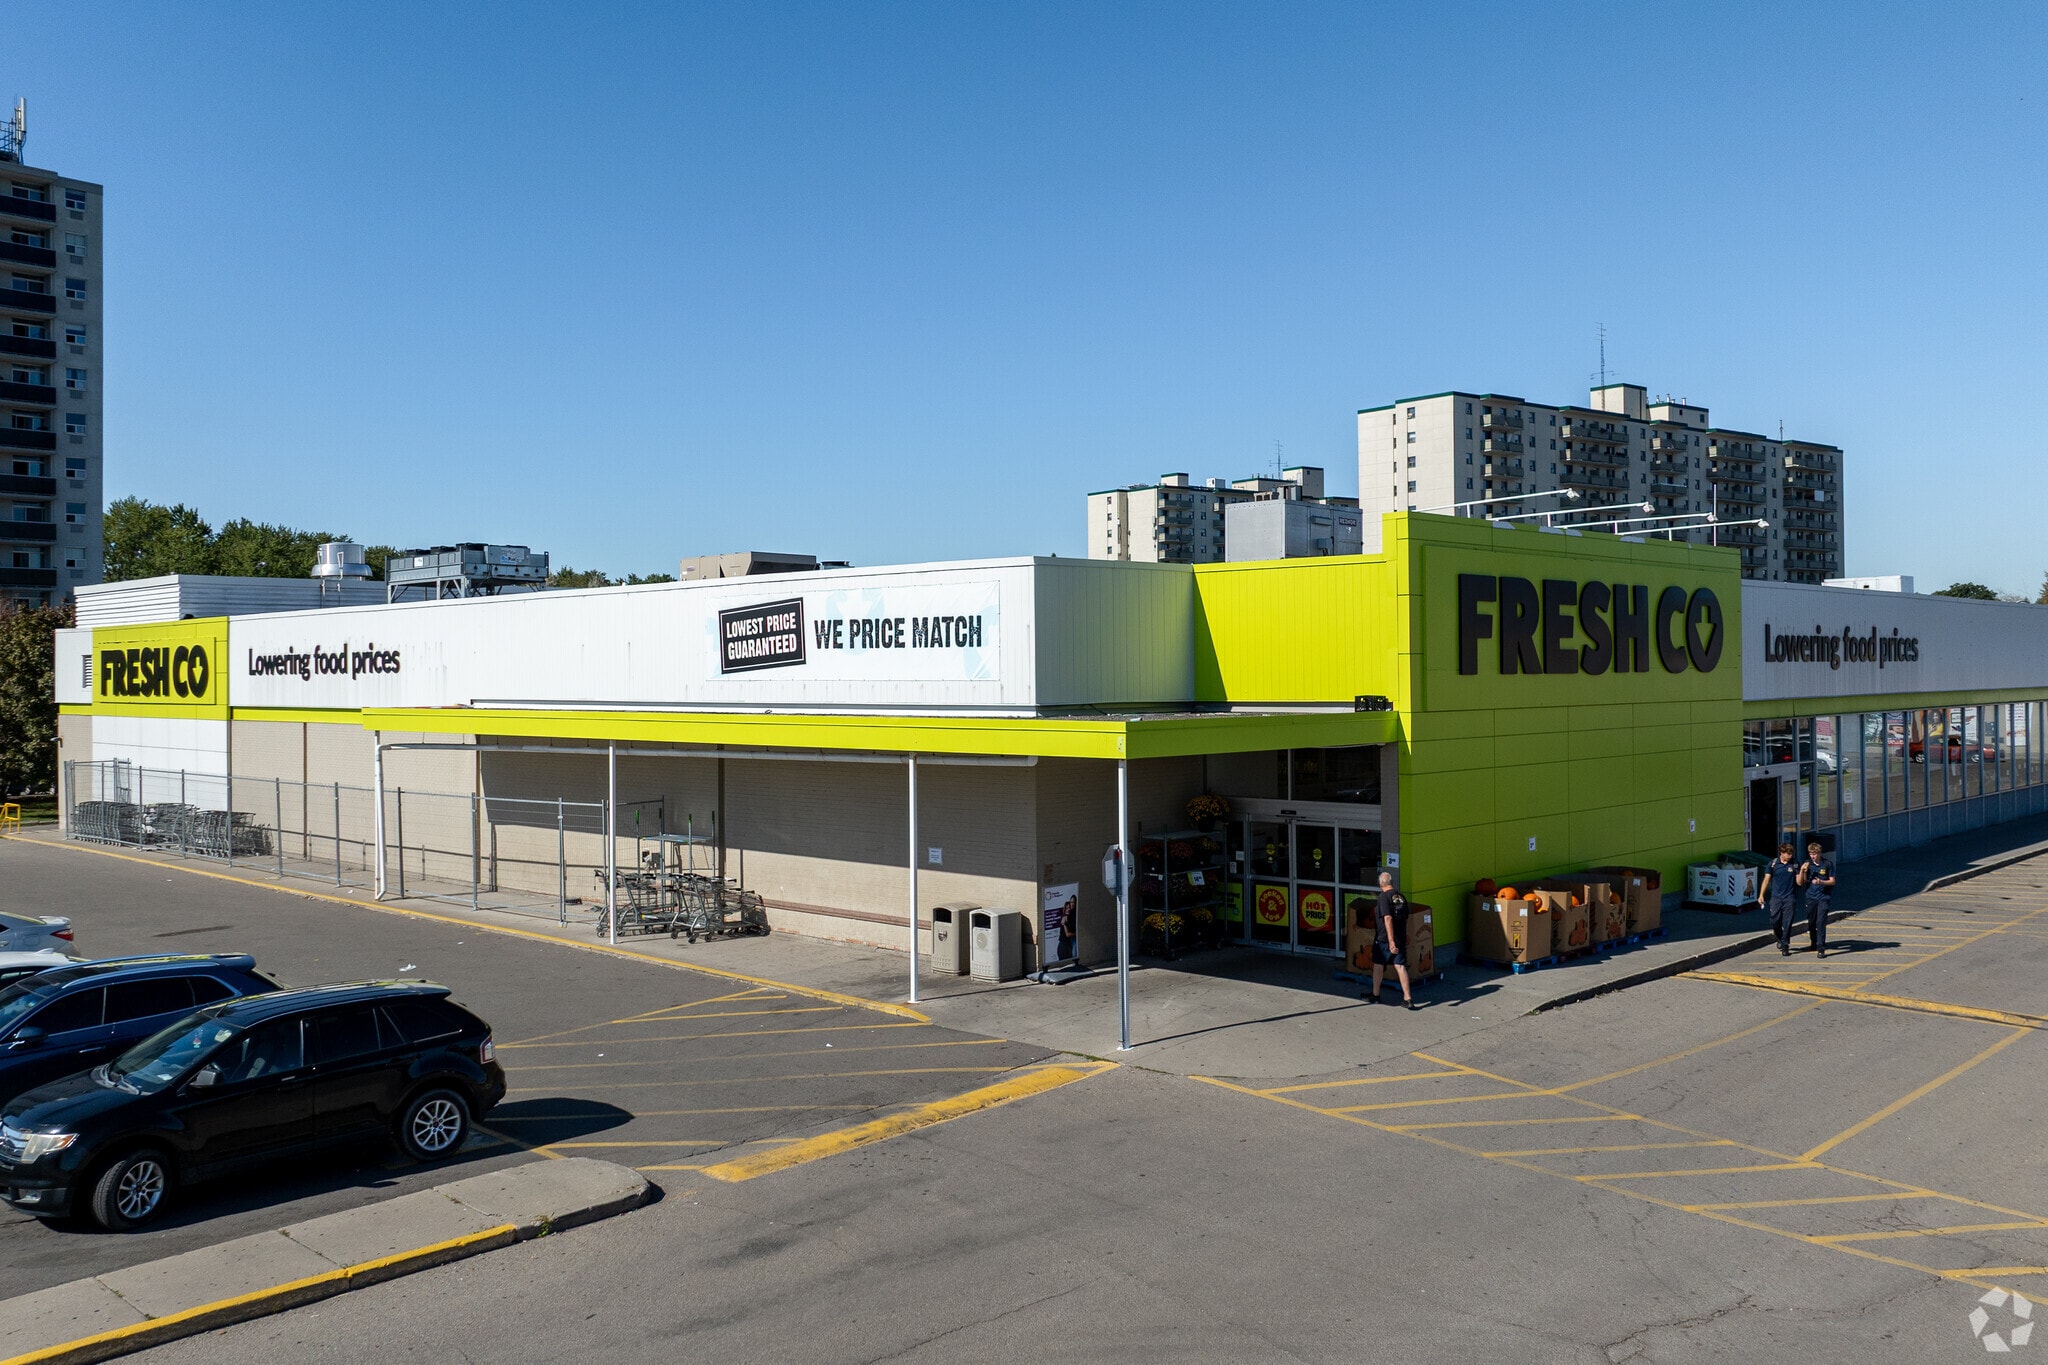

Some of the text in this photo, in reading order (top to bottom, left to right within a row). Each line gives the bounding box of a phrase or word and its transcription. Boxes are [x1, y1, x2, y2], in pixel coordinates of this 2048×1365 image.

[726, 612, 796, 639] LOWEST PRICE
[814, 615, 982, 649] WE PRICE MATCH
[1458, 573, 1723, 675] FRESH CO
[248, 642, 401, 682] Lowering food prices
[728, 634, 797, 661] GUARANTEED
[1765, 624, 1919, 671] Lowering food prices
[100, 645, 209, 698] FRESH CO
[1267, 899, 1277, 911] &
[1306, 901, 1327, 911] HOT
[1306, 910, 1327, 920] PRICE
